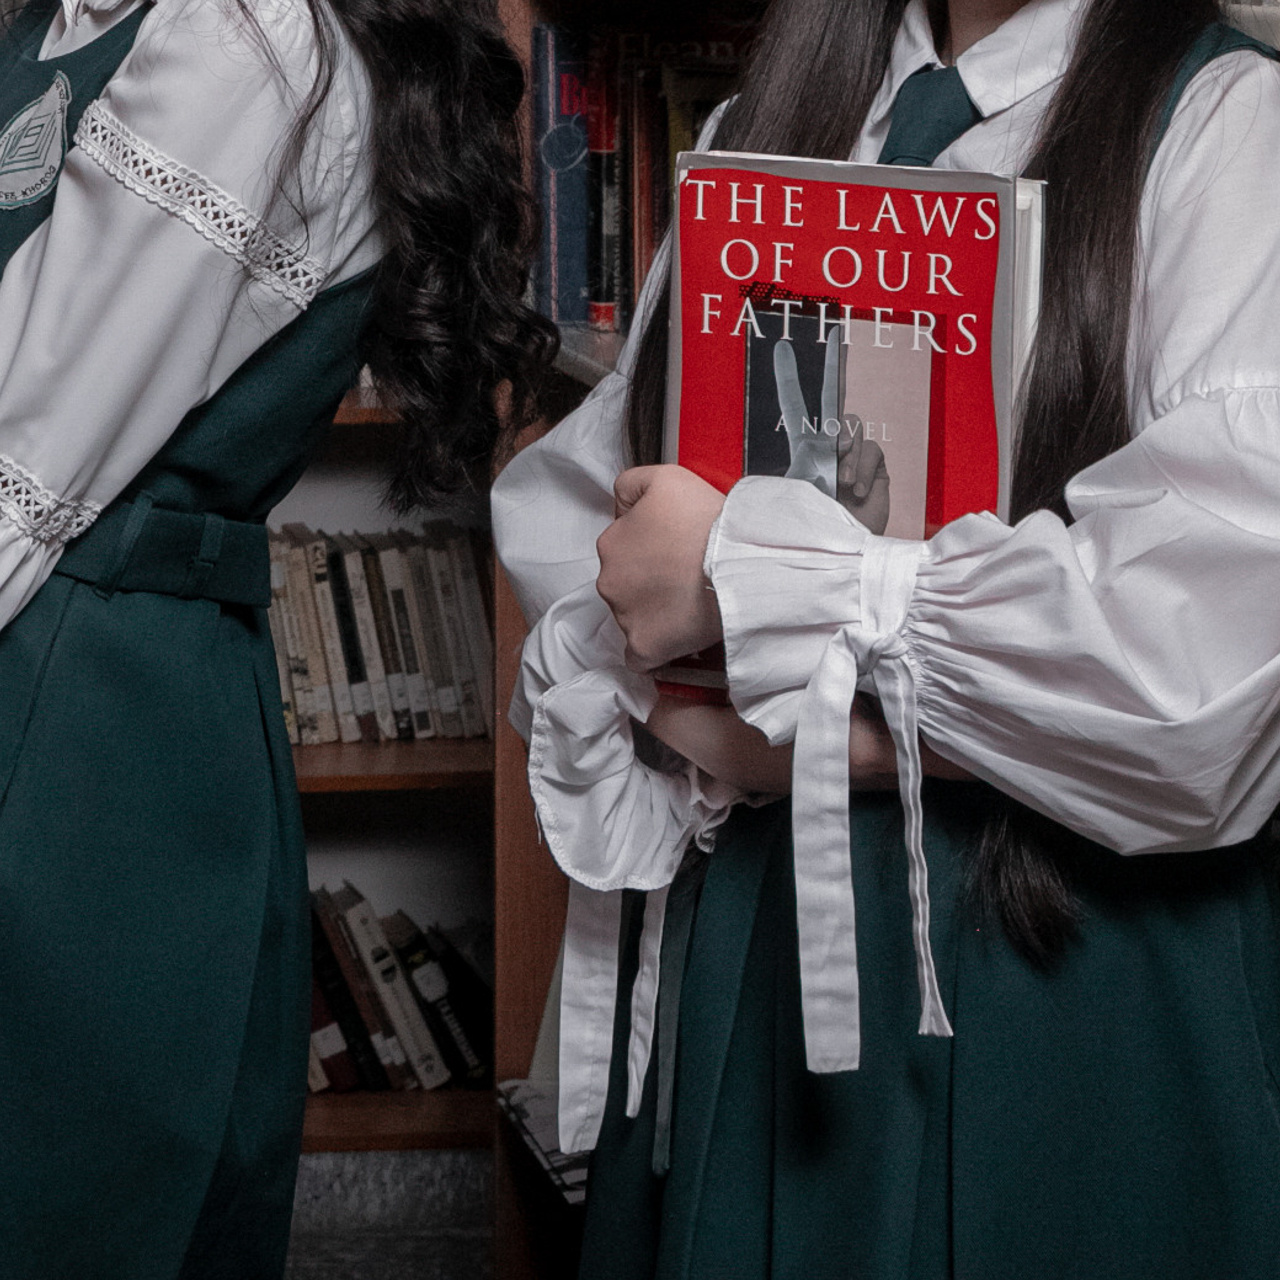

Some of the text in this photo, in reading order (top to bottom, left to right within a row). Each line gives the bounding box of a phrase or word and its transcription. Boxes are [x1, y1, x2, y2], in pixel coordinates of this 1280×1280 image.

[685, 178, 998, 241] THE LAWS
[719, 238, 964, 297] OF OUR
[700, 292, 979, 356] FATHERS
[774, 416, 893, 443] A NOVEL
